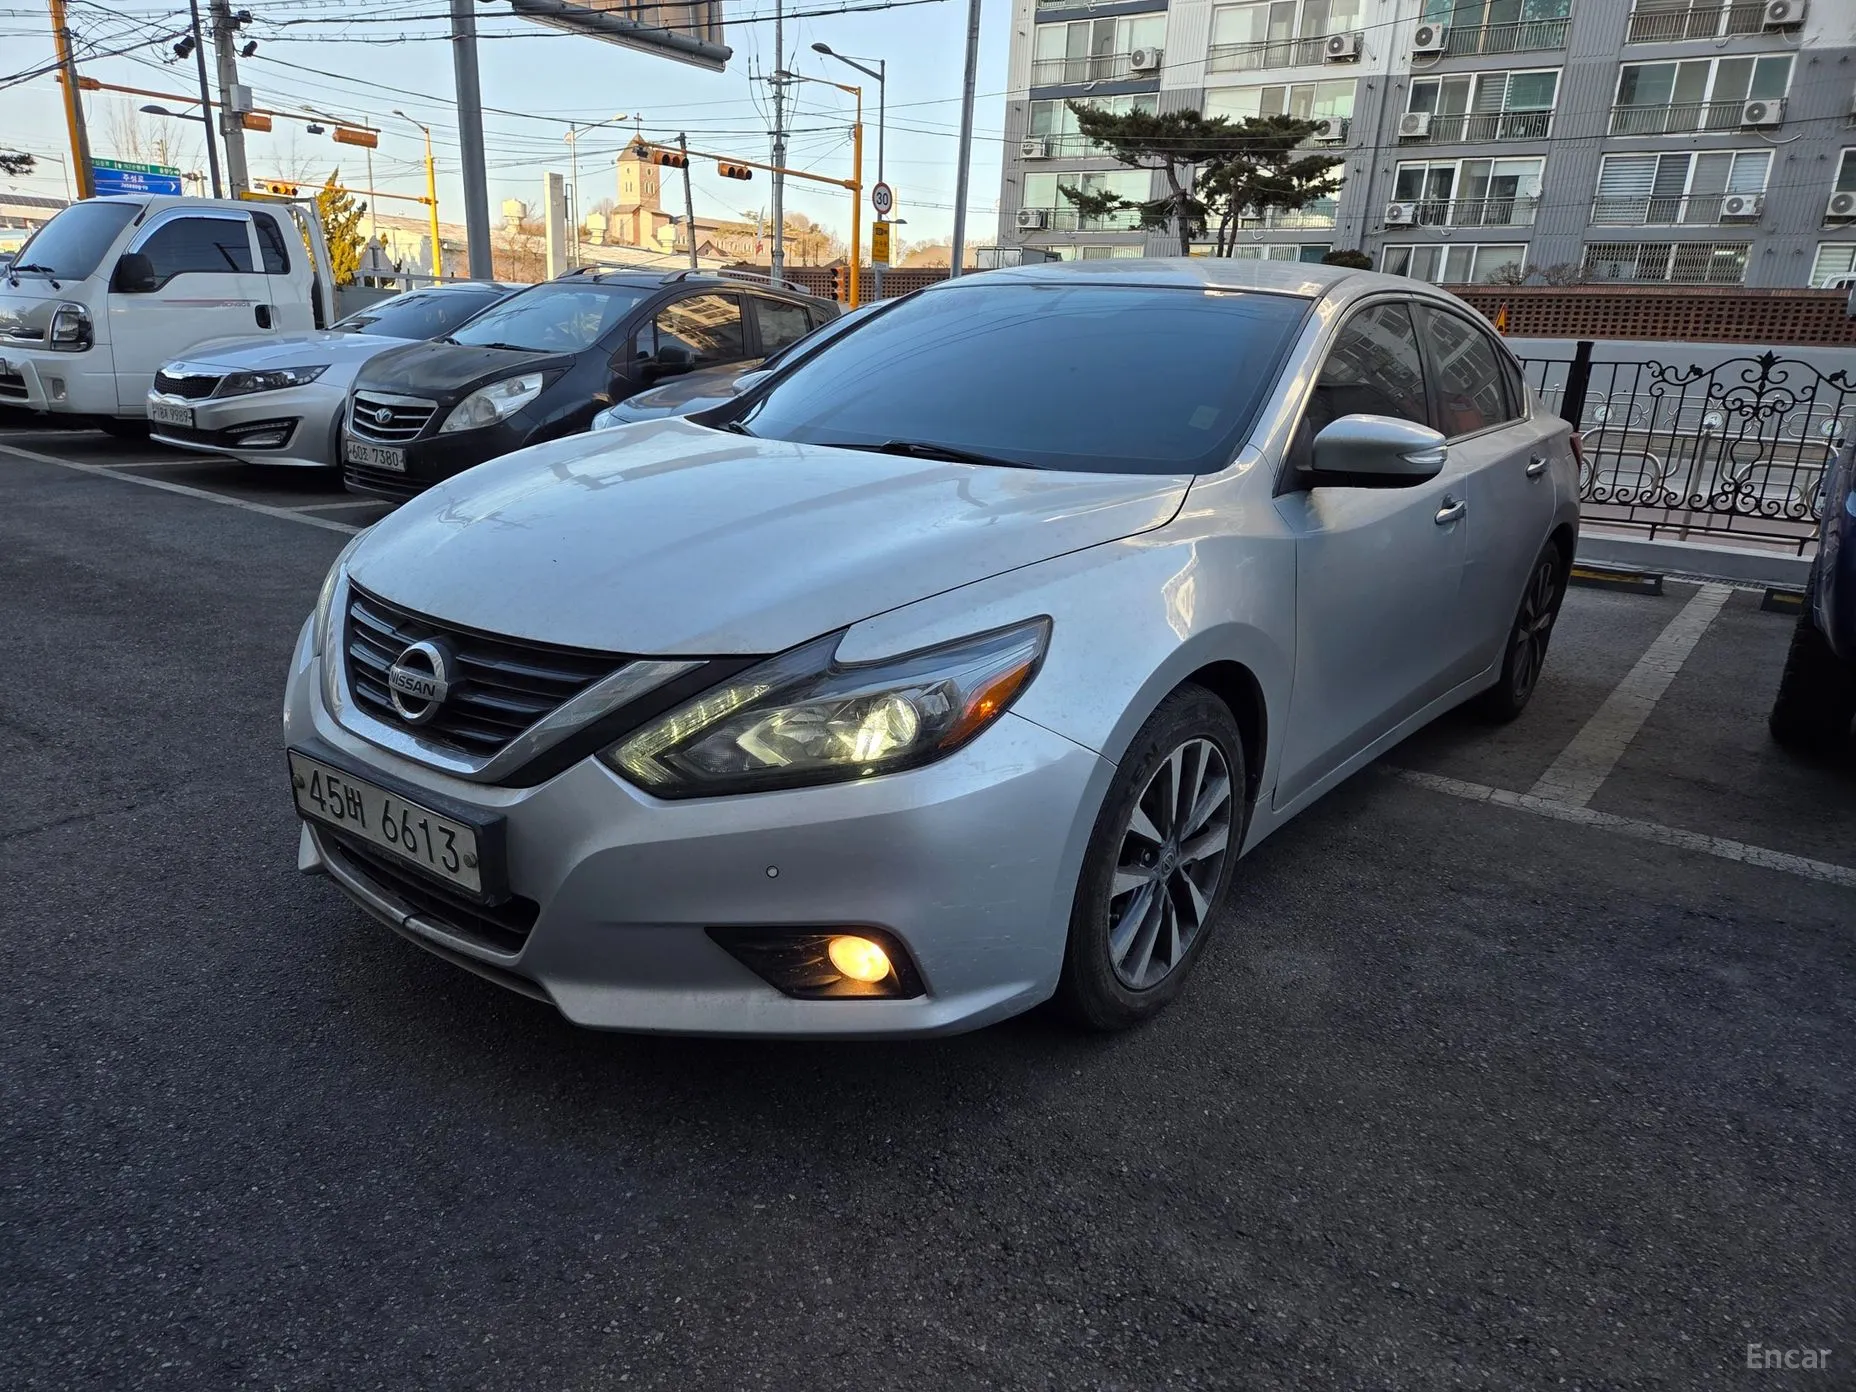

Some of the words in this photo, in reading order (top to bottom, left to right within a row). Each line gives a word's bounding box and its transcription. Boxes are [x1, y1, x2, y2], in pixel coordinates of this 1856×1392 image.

[876, 192, 888, 205] 30
[372, 448, 399, 467] 7380
[390, 670, 436, 697] NISSAN
[309, 769, 367, 829] 45버
[382, 799, 460, 874] 6613
